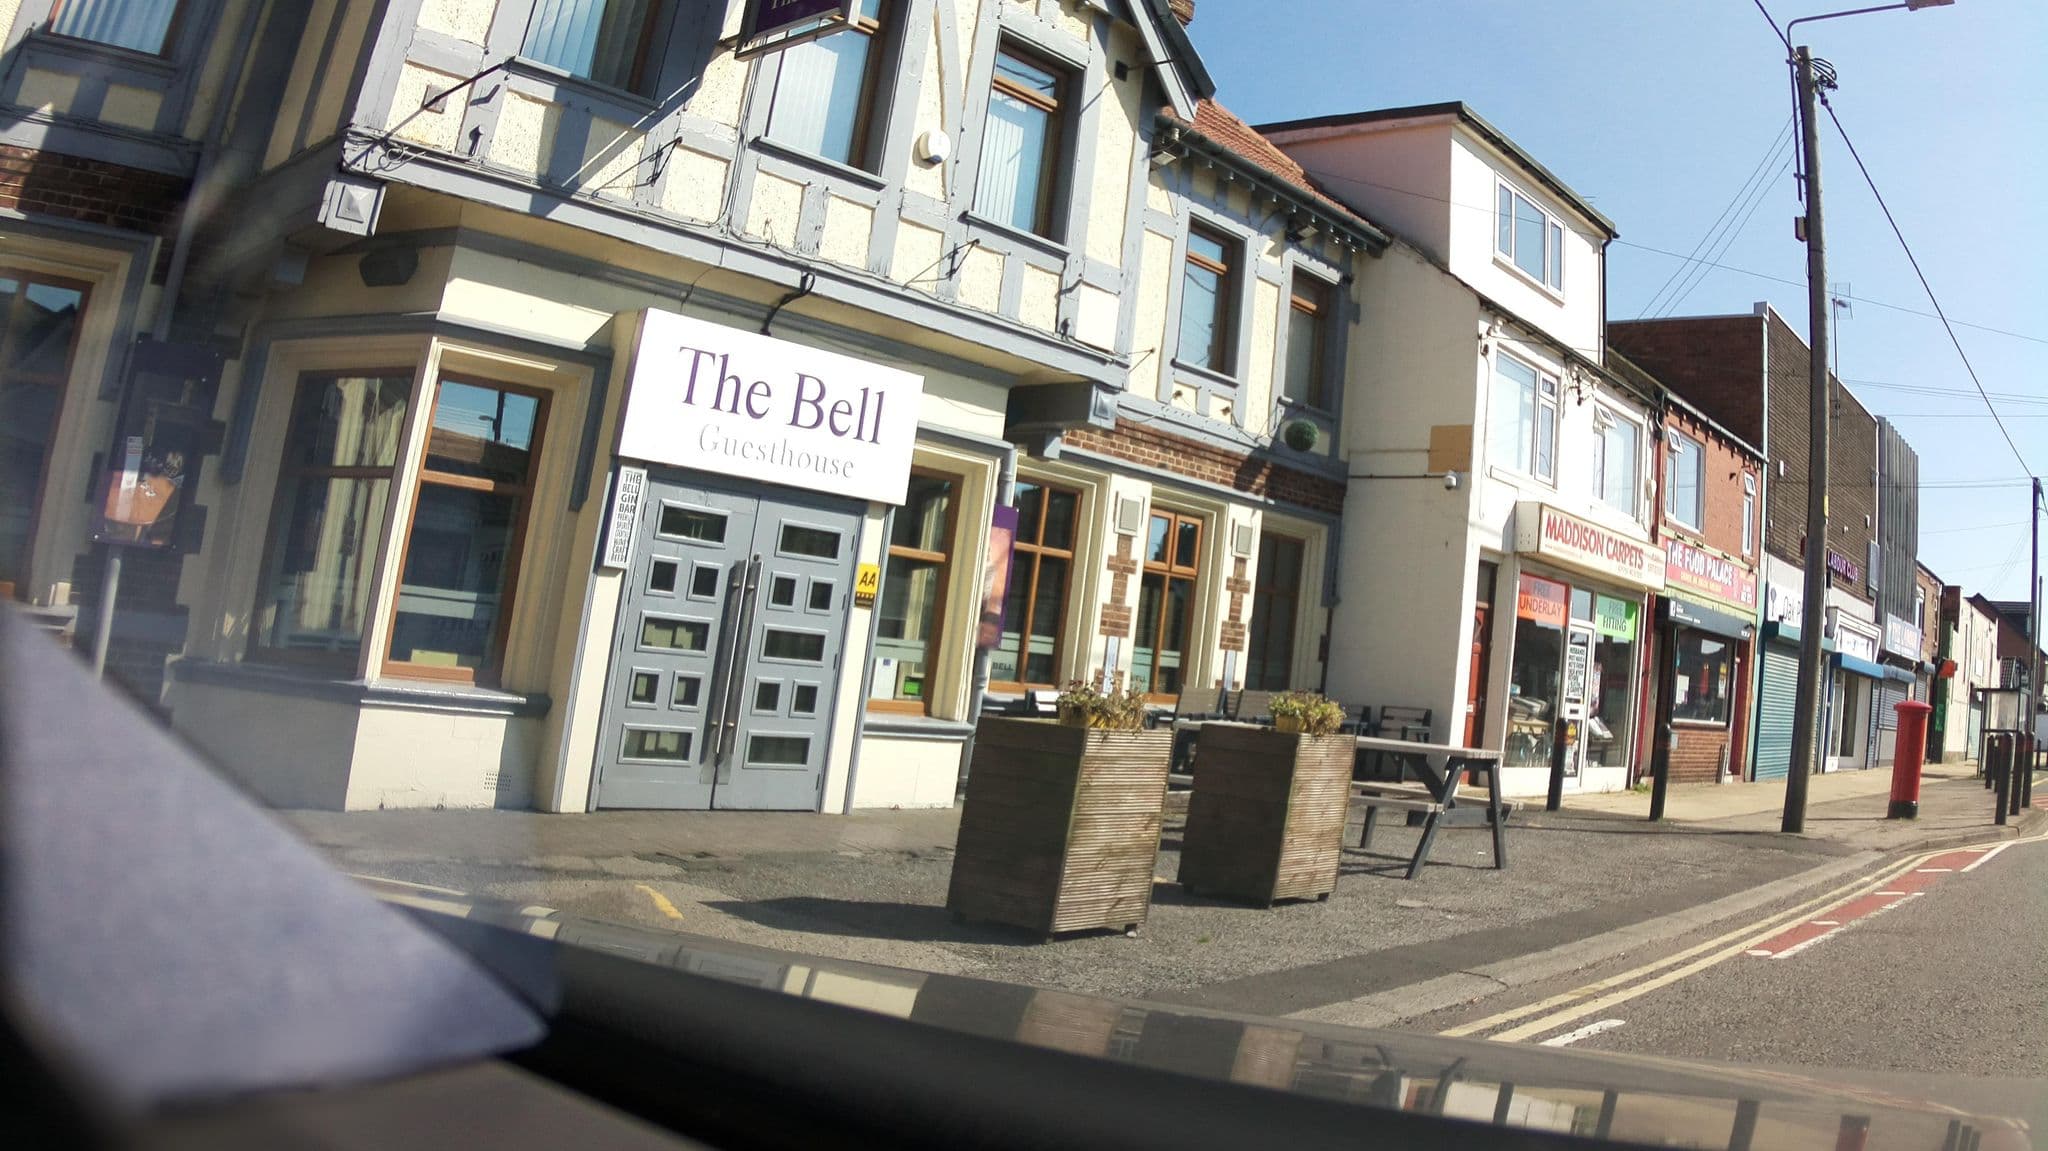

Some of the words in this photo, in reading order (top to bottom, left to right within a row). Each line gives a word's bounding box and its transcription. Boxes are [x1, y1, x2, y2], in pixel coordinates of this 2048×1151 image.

[679, 346, 772, 420] The
[786, 372, 885, 445] Bell
[699, 423, 855, 479] Guesthouse
[624, 471, 642, 484] THE
[622, 483, 639, 494] BELL
[621, 493, 638, 504] GIN
[1545, 512, 1605, 557] MADDISON
[1606, 535, 1644, 570] CARPETS
[1666, 540, 1683, 568] THE
[1684, 547, 1705, 576] FOOD
[1706, 556, 1733, 587] PALACE
[858, 571, 876, 587] AA
[1520, 596, 1562, 617] UNDERLAY
[1602, 615, 1627, 632] FITTING
